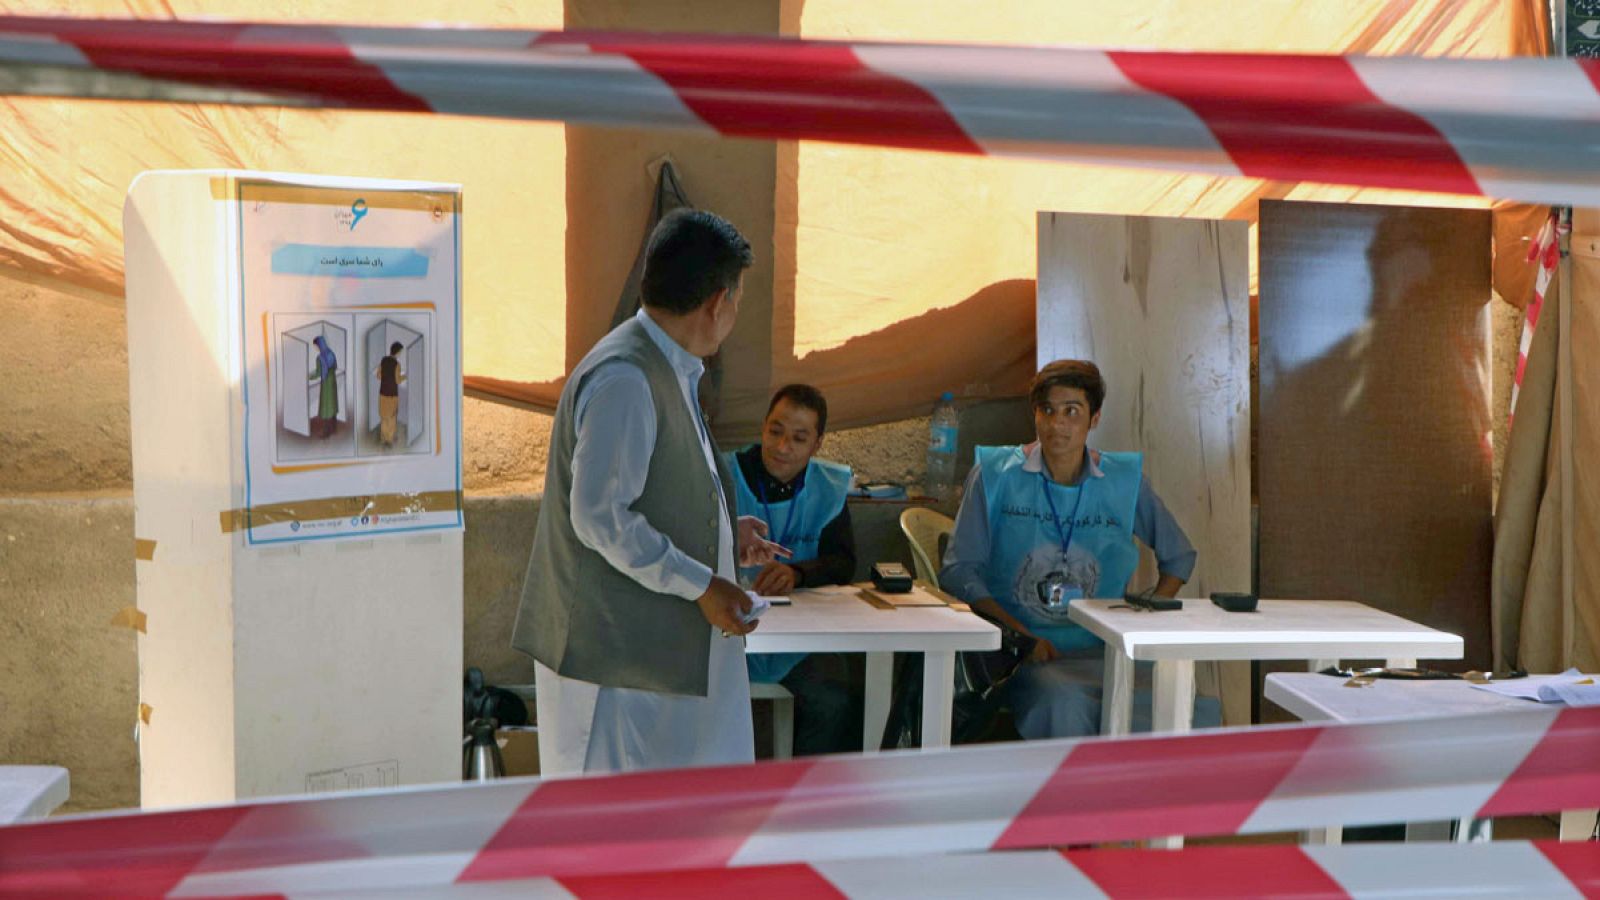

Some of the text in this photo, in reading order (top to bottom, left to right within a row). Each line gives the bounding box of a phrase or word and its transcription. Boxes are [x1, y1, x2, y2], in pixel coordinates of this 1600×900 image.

[320, 255, 338, 265] است
[339, 257, 355, 266] سری
[356, 255, 370, 266] شما
